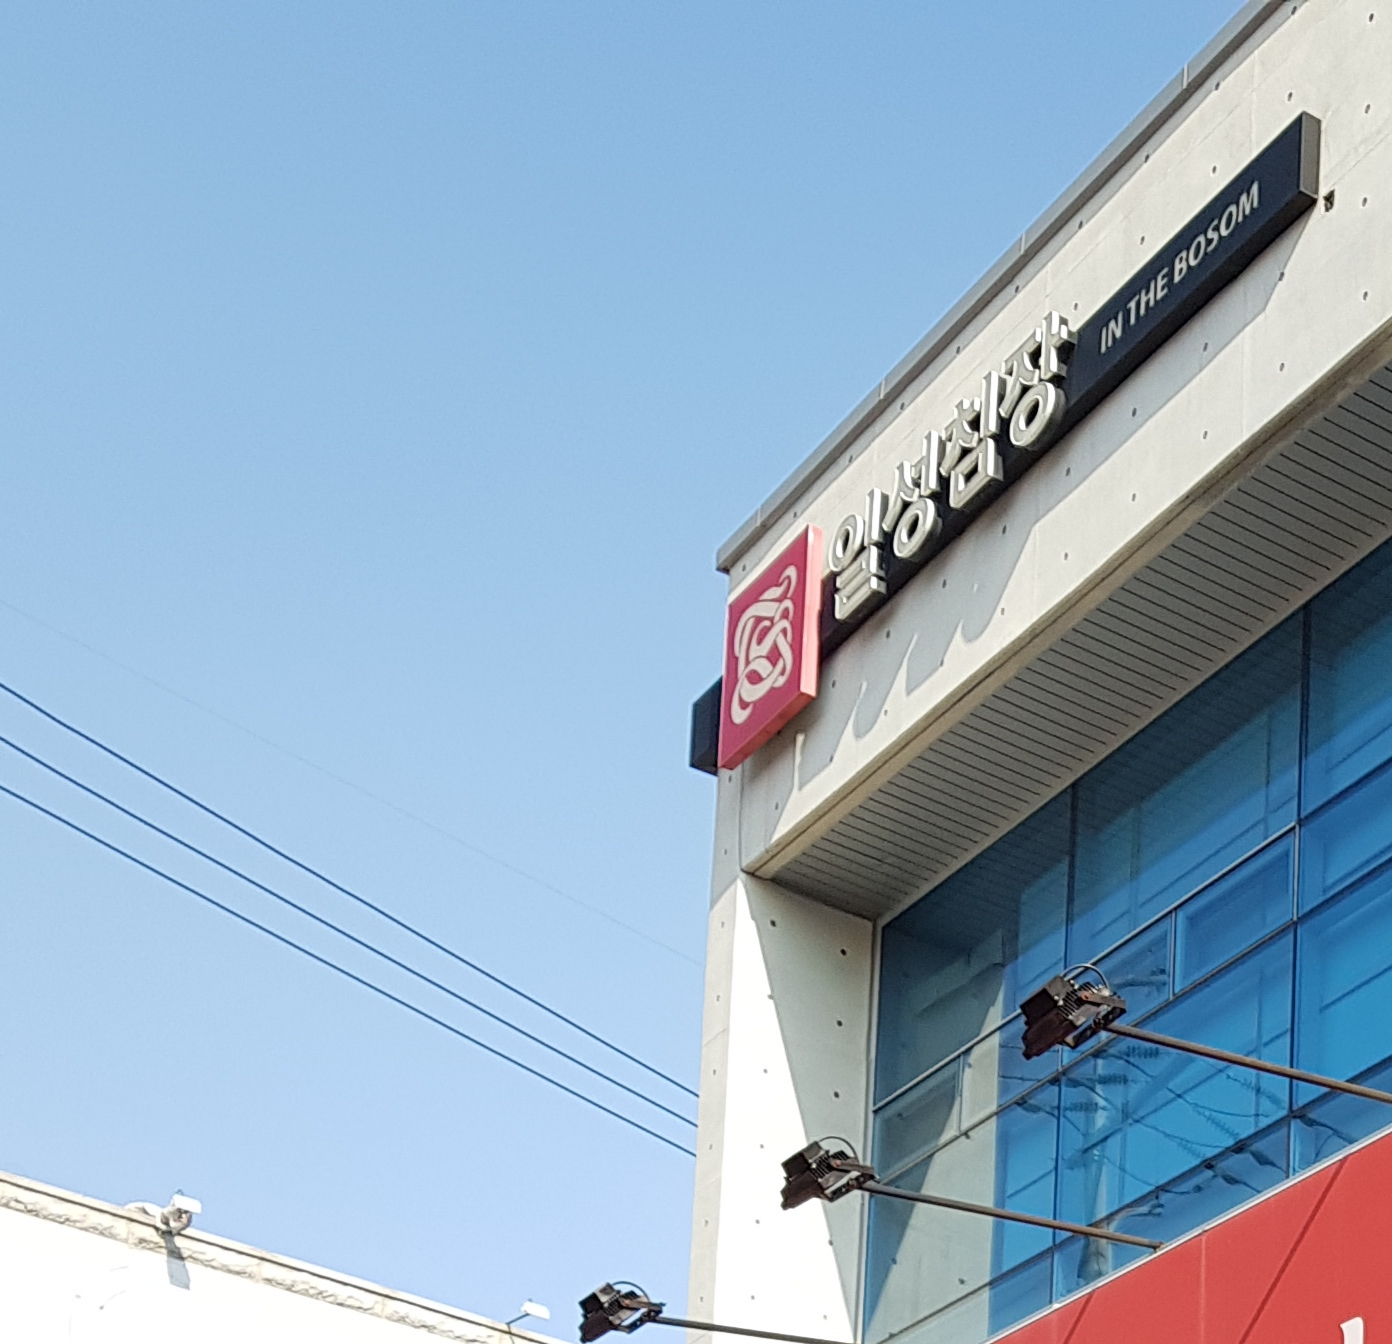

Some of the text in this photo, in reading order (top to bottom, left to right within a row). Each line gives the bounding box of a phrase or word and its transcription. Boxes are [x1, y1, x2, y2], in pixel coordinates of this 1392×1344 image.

[1100, 180, 1259, 354] IN THE BOSOM
[828, 311, 1078, 621] 일성침장
